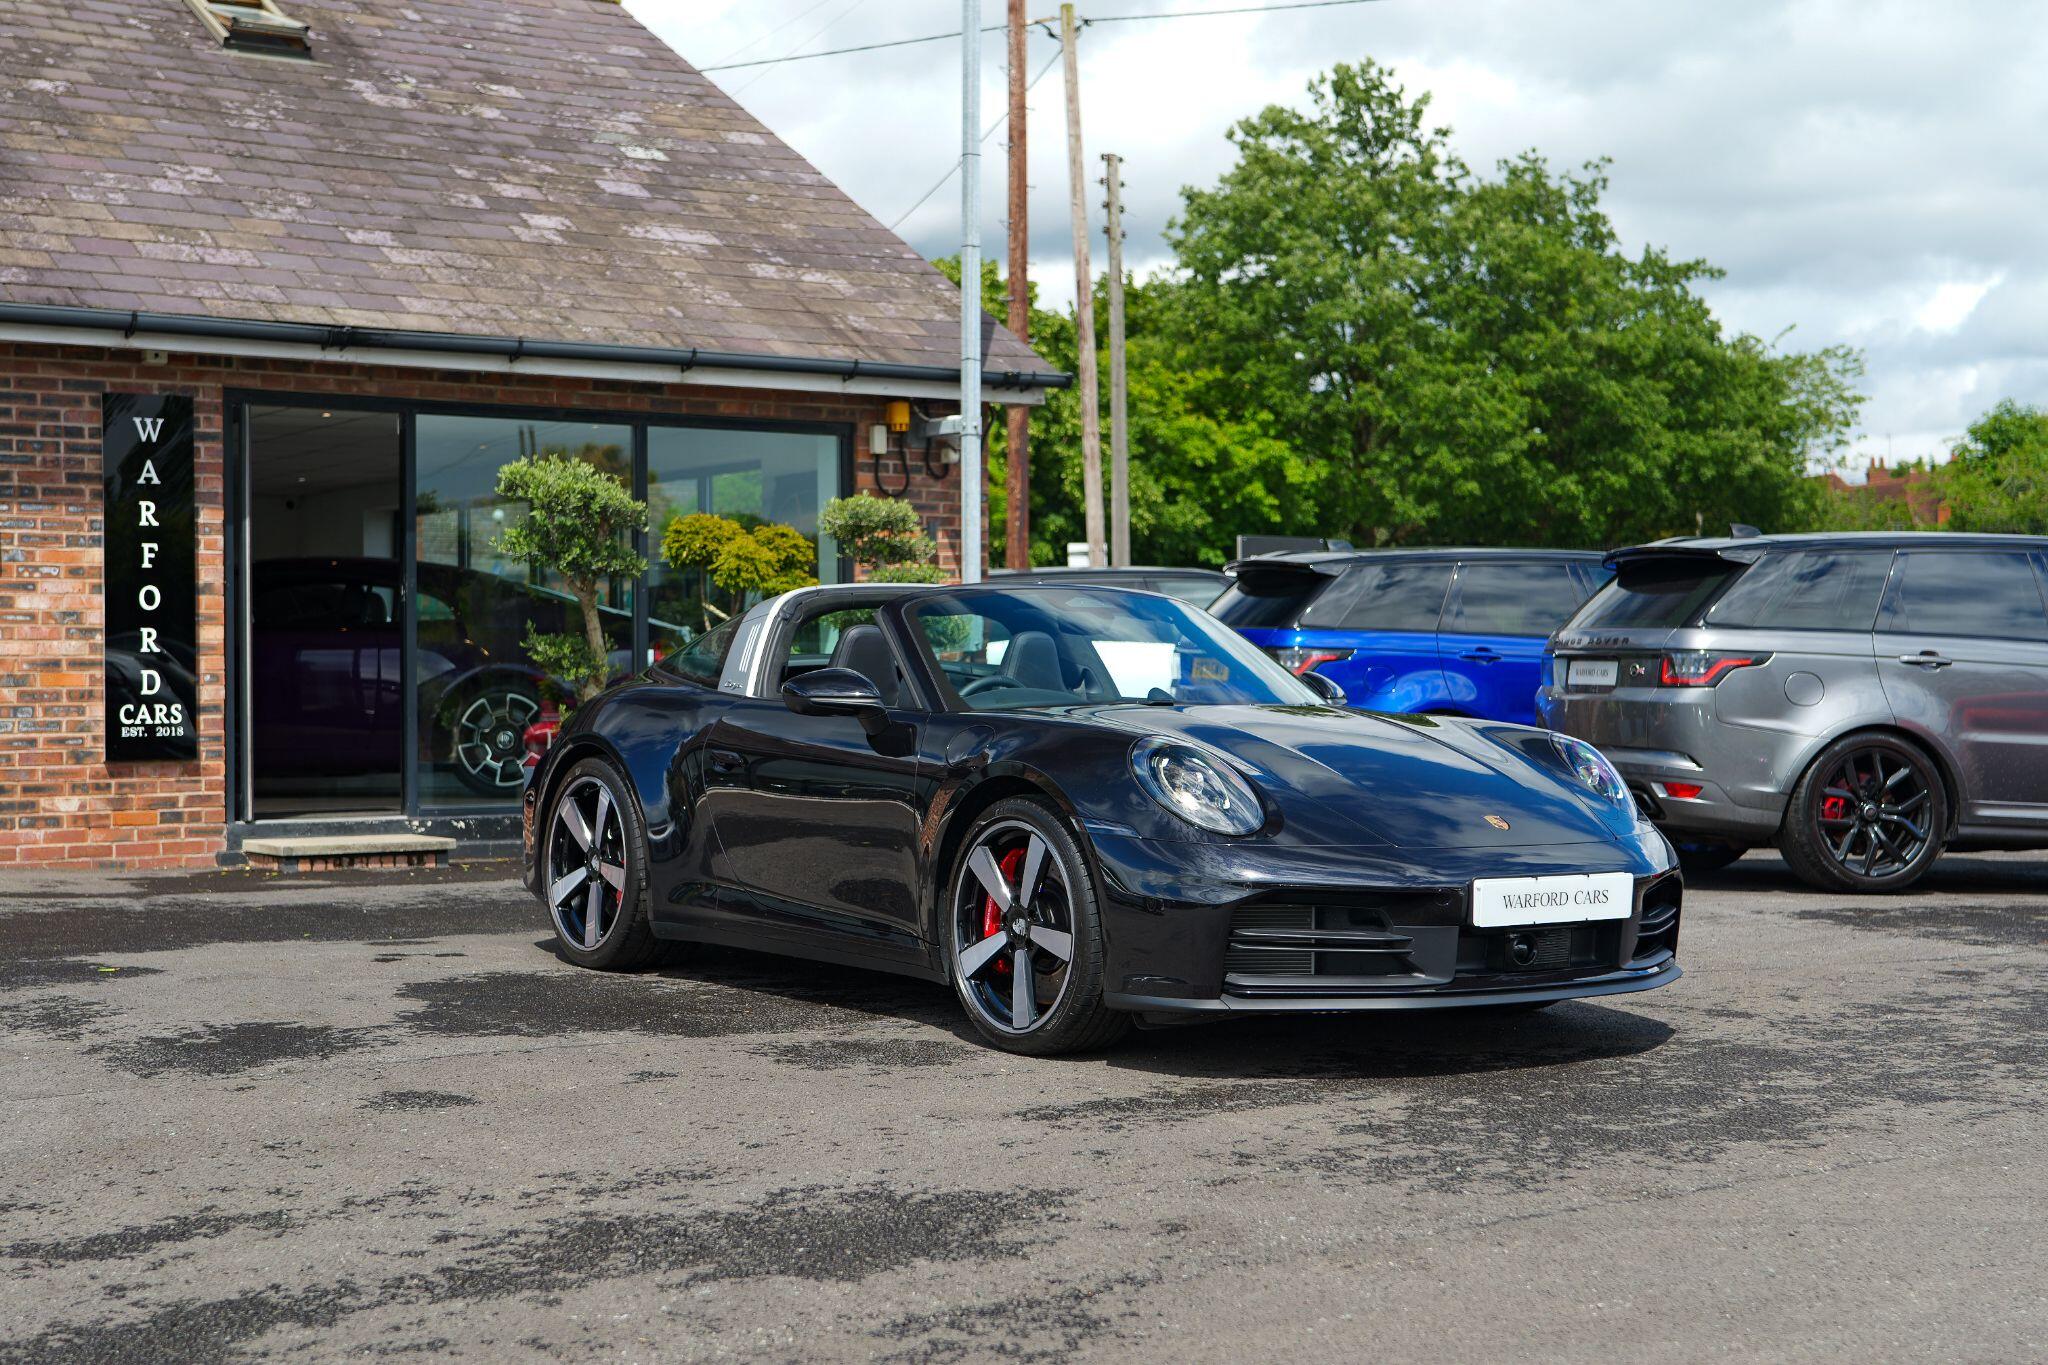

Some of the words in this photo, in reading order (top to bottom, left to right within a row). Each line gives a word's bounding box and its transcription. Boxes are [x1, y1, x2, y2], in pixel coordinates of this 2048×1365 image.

[132, 417, 164, 696] WARFORD
[119, 704, 183, 725] CARS
[121, 727, 147, 738] EST.
[156, 726, 184, 737] 2018
[1503, 891, 1569, 909] WARFORD
[1574, 890, 1609, 905] CARS
